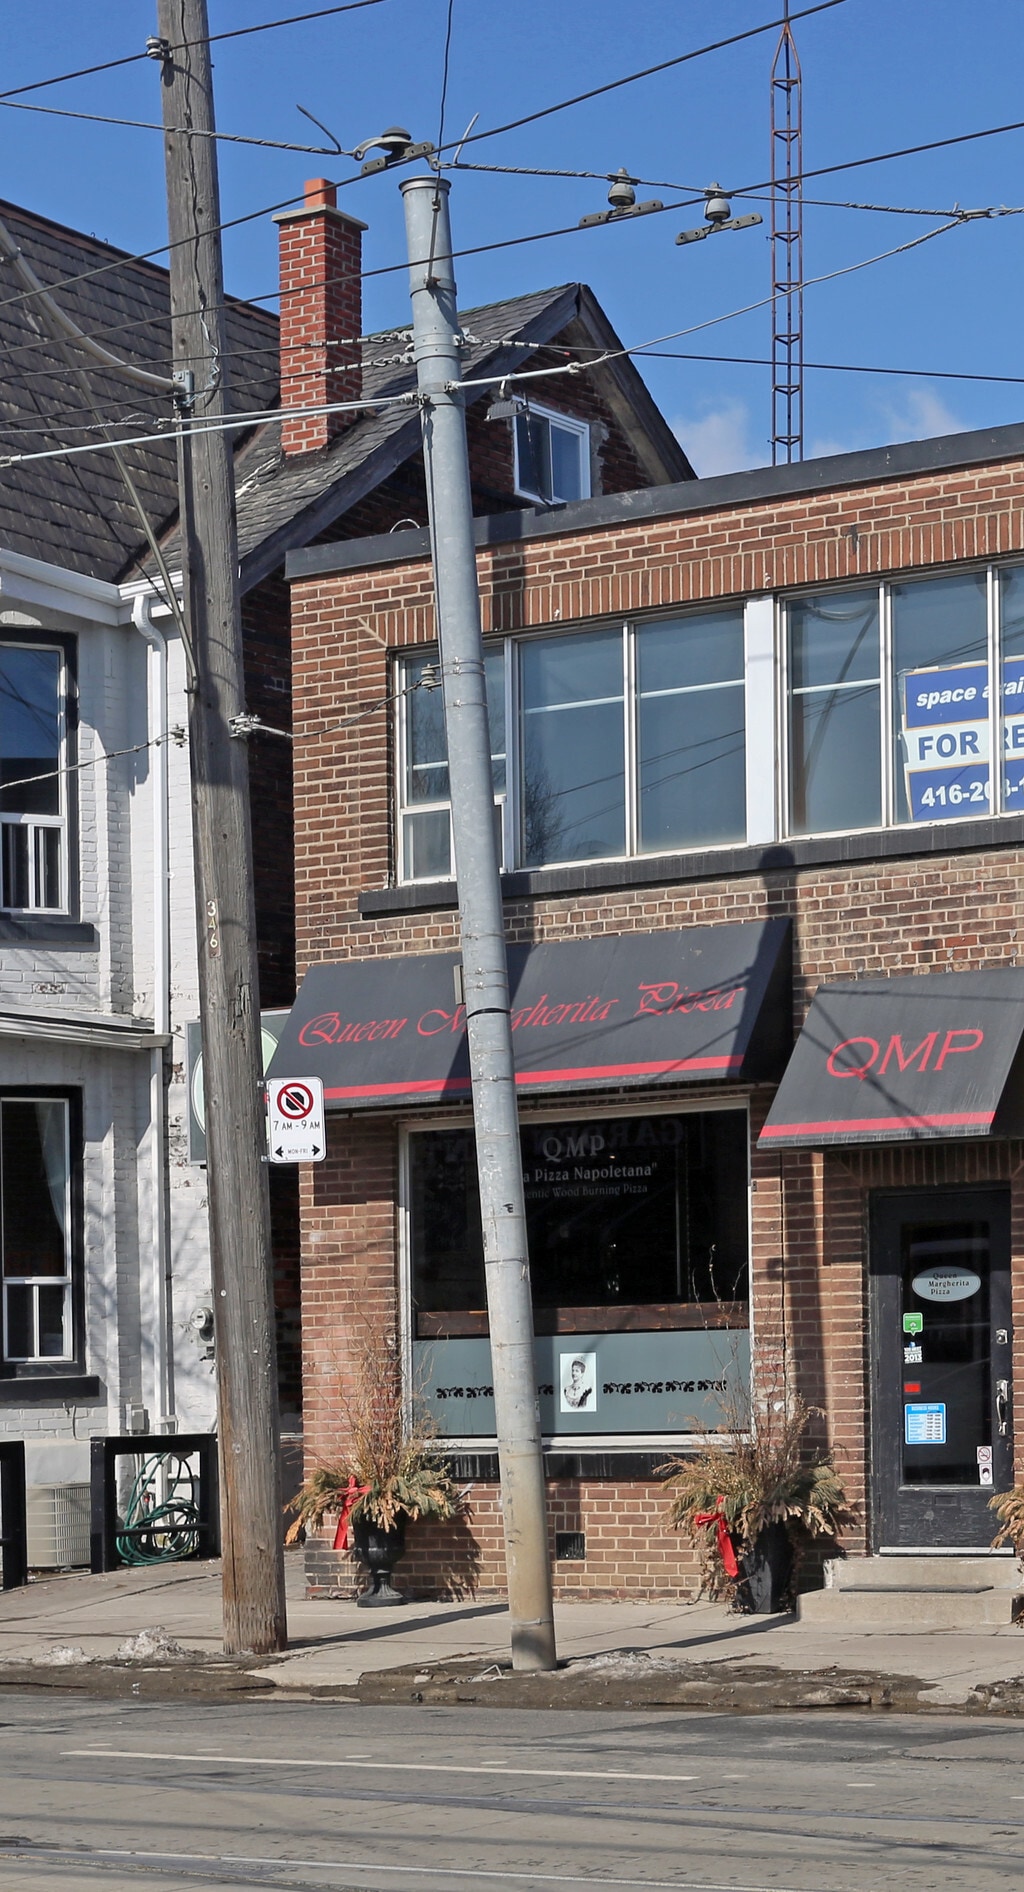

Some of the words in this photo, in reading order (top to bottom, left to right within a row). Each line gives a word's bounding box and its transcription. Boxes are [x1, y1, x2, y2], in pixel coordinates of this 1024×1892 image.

[916, 685, 977, 709] space
[918, 730, 979, 761] FOR
[298, 1011, 408, 1047] Queen
[416, 993, 620, 1037] Mgherita
[633, 981, 745, 1017] Pizza
[826, 1028, 985, 1081] QMP
[273, 1120, 279, 1131] 7
[281, 1122, 293, 1131] AM
[301, 1119, 307, 1130] 9
[309, 1121, 321, 1130] AM
[542, 1134, 606, 1163] QMP
[534, 1167, 569, 1183] Pizza
[574, 1162, 659, 1182] Napoletana"
[552, 1186, 579, 1198] Wood
[582, 1184, 621, 1196] Burning
[623, 1183, 648, 1193] Pizza
[928, 1279, 970, 1288] Margherita
[932, 1272, 958, 1280] Queen
[904, 1353, 923, 1362] 2013
